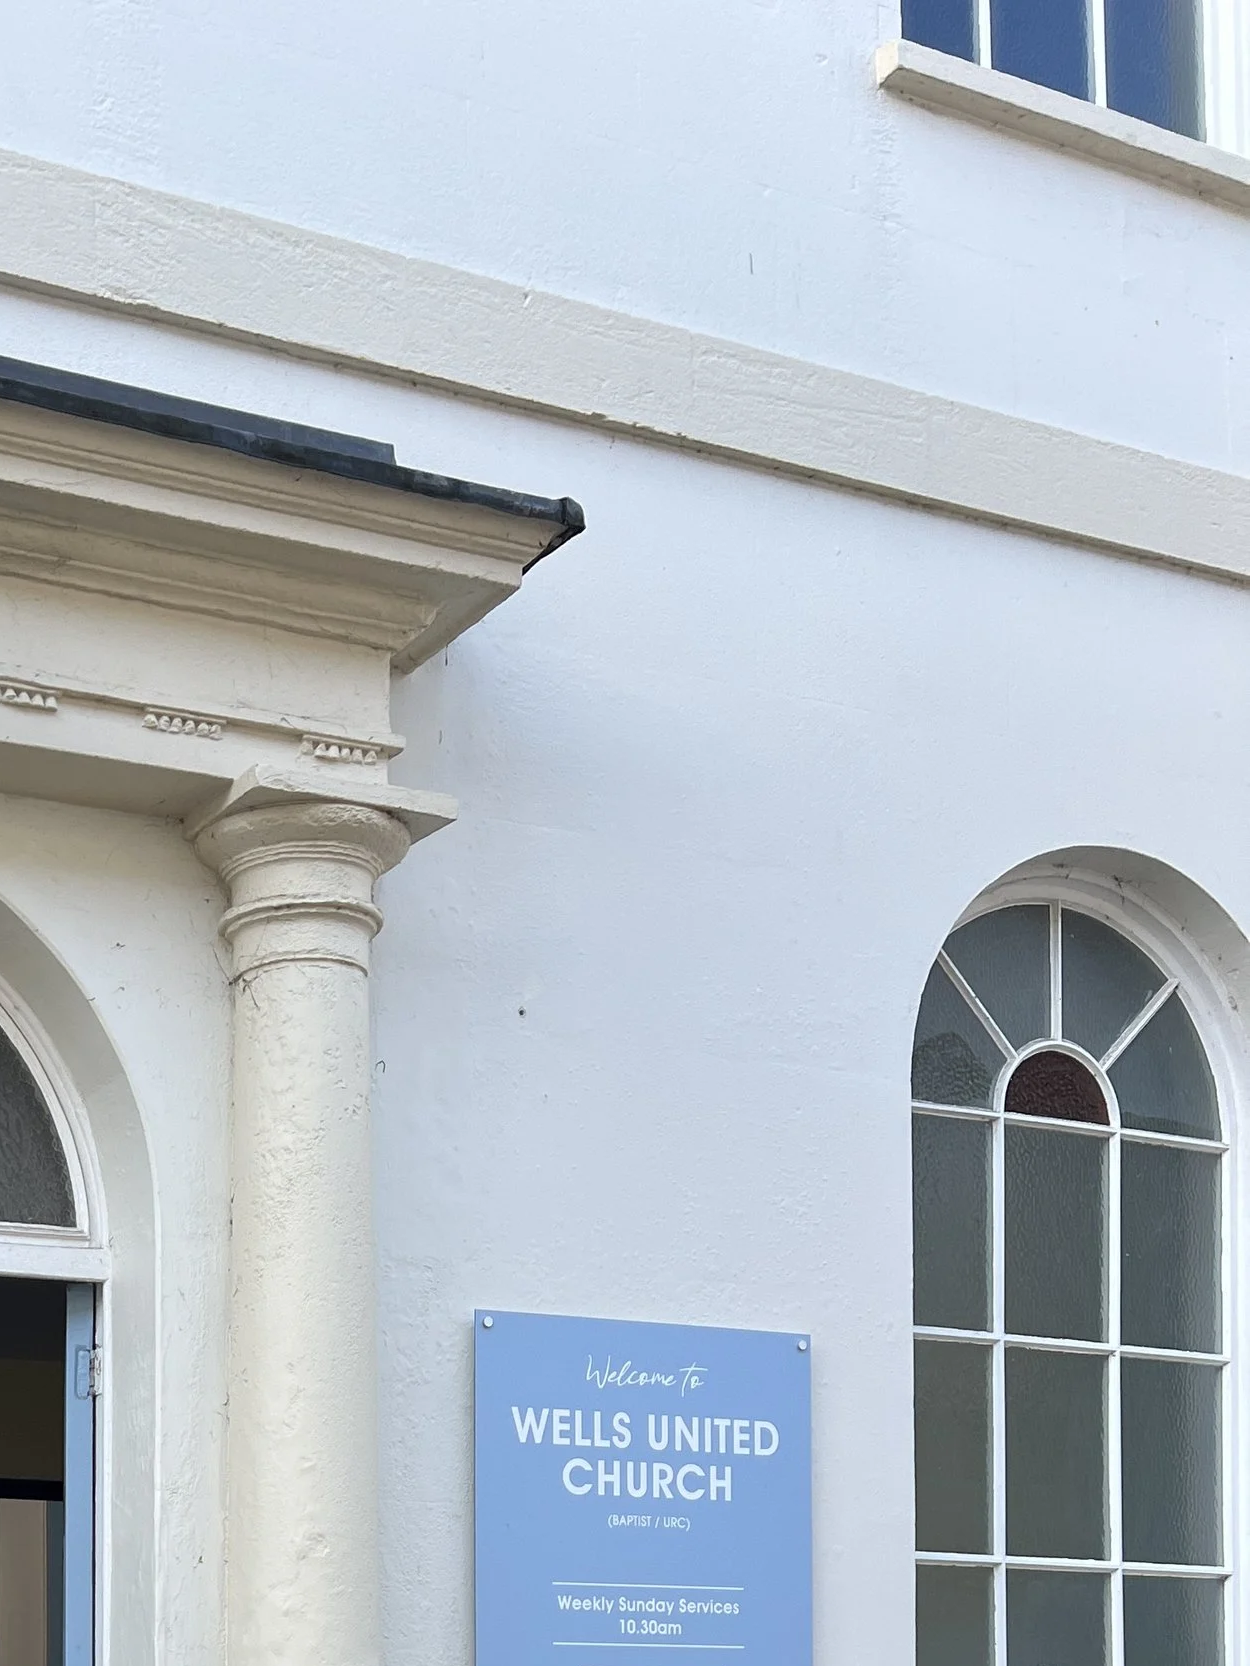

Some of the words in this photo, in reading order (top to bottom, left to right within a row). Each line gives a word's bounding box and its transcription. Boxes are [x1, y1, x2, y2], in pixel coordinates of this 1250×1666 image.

[587, 1355, 676, 1388] Welcome
[680, 1362, 708, 1397] to
[512, 1407, 631, 1448] WELLS
[649, 1414, 779, 1455] UNITED
[563, 1458, 731, 1501] CHURCH
[608, 1514, 651, 1528] (BAPTIST
[664, 1517, 690, 1531] URC)
[558, 1595, 614, 1614] Weekly
[619, 1597, 674, 1615] Sunday
[679, 1599, 739, 1614] Services
[620, 1620, 681, 1634] 10.30am
